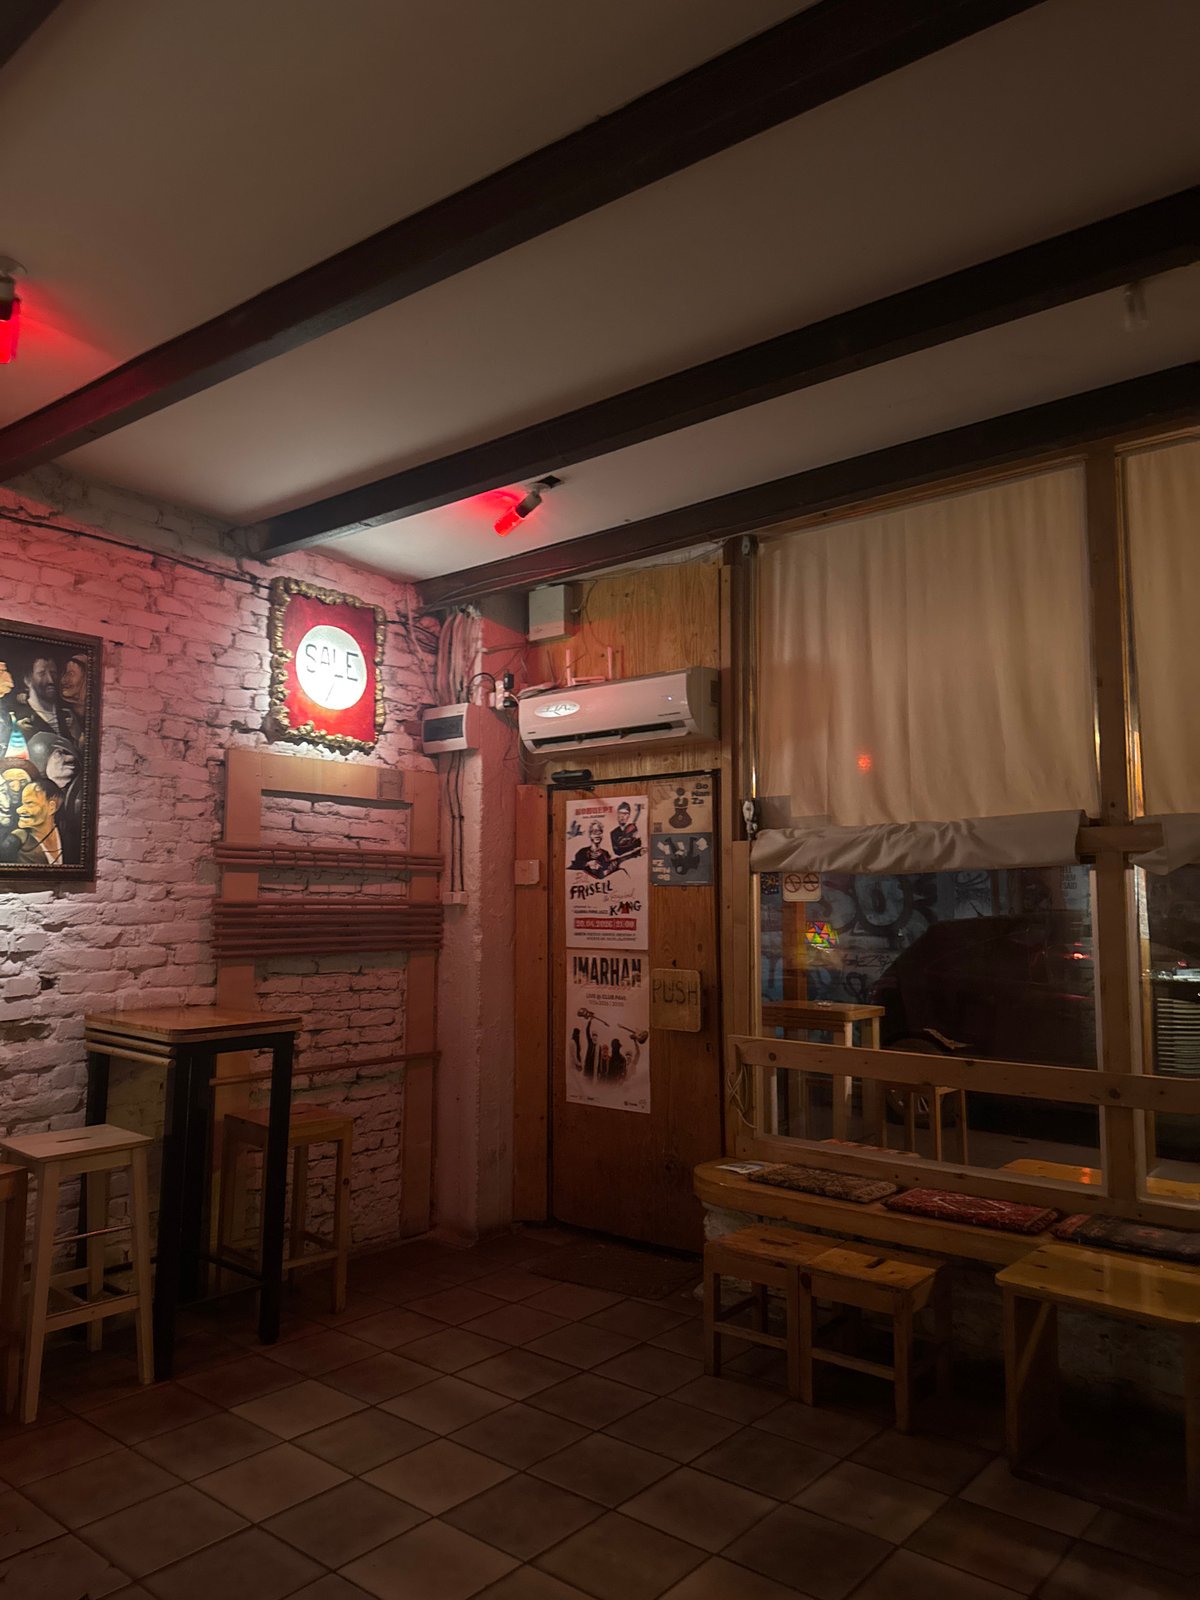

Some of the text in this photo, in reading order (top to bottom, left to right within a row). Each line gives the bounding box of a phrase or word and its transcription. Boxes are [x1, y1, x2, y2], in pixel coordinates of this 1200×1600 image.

[305, 643, 359, 682] SALE
[570, 880, 613, 900] FRISELL
[573, 956, 641, 988] IMARHAN
[652, 979, 698, 1006] PUSH
